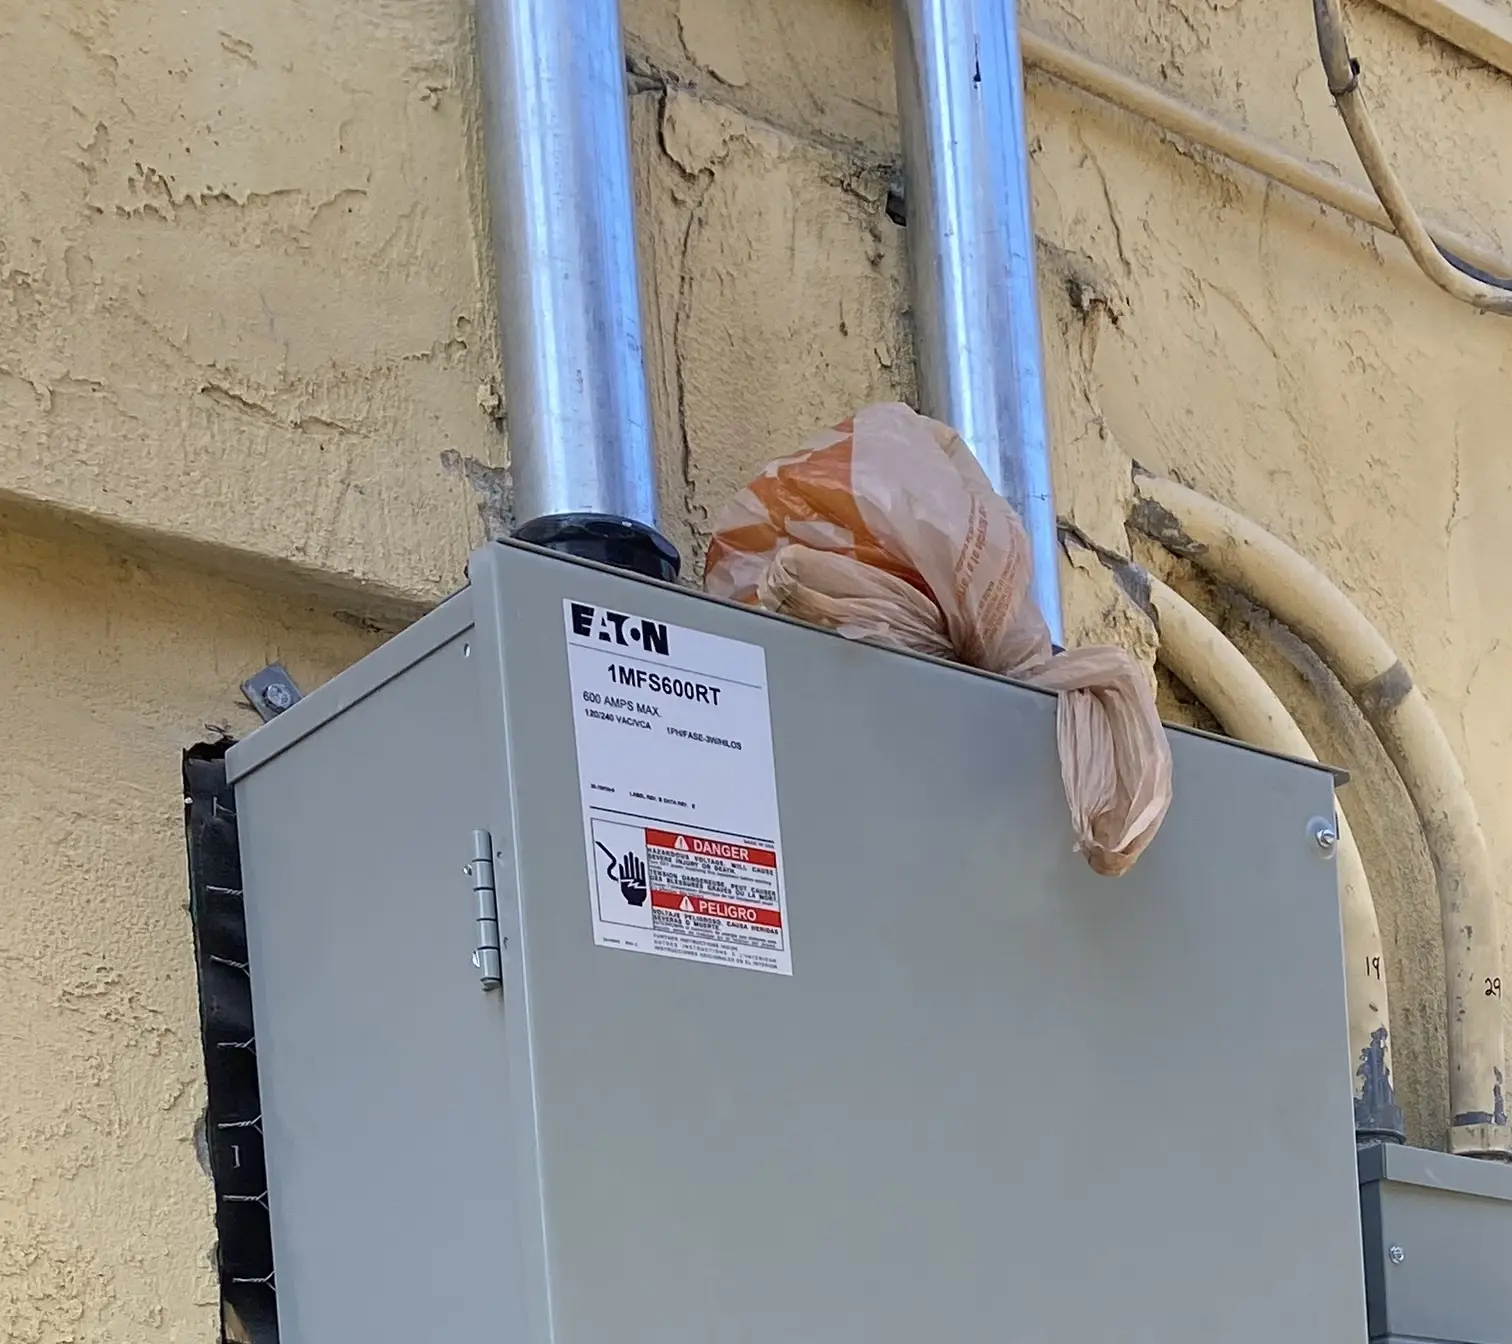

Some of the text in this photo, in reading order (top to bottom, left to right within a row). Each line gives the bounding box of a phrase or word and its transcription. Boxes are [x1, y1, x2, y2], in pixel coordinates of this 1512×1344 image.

[571, 603, 669, 656] EATON
[607, 664, 721, 705] 1MFS600RT
[583, 690, 601, 704] 600
[603, 694, 634, 712] AMPS
[584, 708, 615, 722] 120/240
[693, 839, 749, 860] DANGER
[647, 848, 690, 860] HAZARDOUS
[752, 867, 774, 876] CAUSE
[675, 858, 698, 868] INJURY
[653, 908, 681, 920] VOLTAJE
[699, 901, 757, 922] PELIGRO
[1366, 956, 1380, 980] 19
[1485, 977, 1501, 1000] 29
